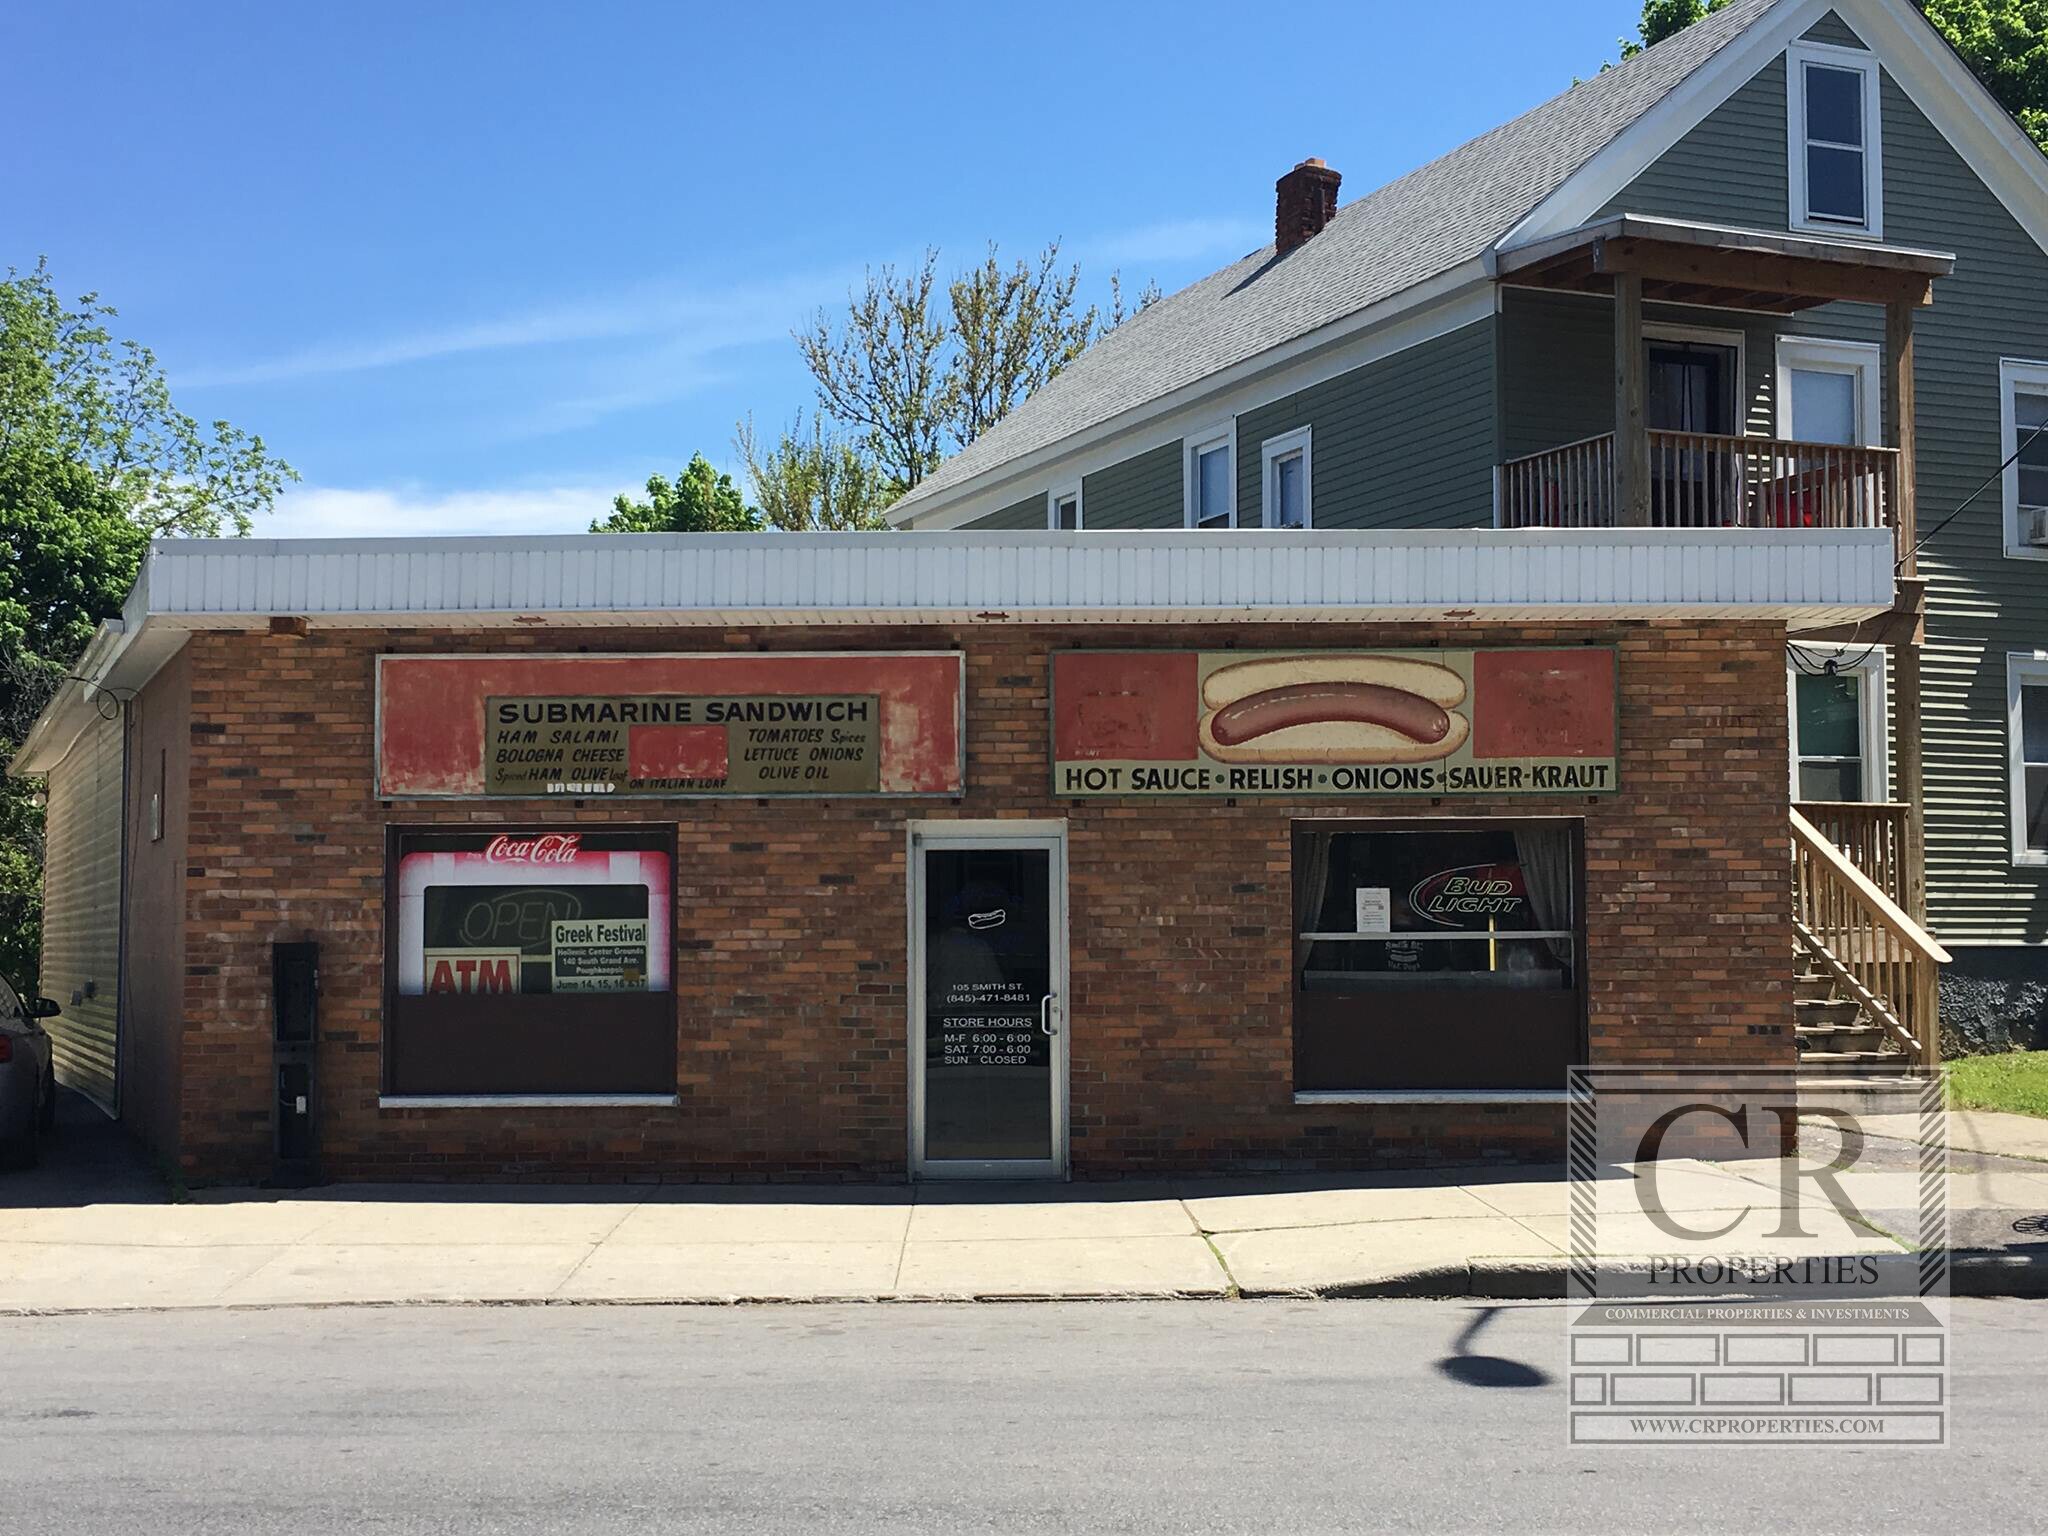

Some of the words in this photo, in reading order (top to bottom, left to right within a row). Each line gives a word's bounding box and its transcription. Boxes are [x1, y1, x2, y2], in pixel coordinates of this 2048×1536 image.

[499, 702, 692, 724] SUBMARINE
[705, 701, 868, 723] SANDWICH
[497, 730, 538, 744] HAM
[549, 729, 619, 744] SALAMI
[748, 728, 824, 743] TOMATOES
[830, 728, 866, 744] Spices
[495, 748, 564, 763] BOLOGNA
[572, 748, 625, 762] CHEESE
[743, 747, 799, 761] LETTUCE
[808, 747, 865, 761] ONIONS
[528, 767, 563, 781] HAM
[571, 767, 609, 781] OLIVE
[758, 766, 800, 780] OLIVE
[804, 765, 830, 779] OIL
[1065, 767, 1123, 791] HOT
[1131, 767, 1210, 791] SAUCE
[1228, 767, 1313, 791] RELISH
[1331, 766, 1435, 791] ONIONS
[1449, 764, 1609, 790] SAUER-KRAUT
[649, 779, 695, 789] ITALIAN
[486, 835, 580, 863] Coca-Cola
[1444, 877, 1512, 895] BUD
[1427, 896, 1522, 914] LIGHT
[463, 902, 572, 941] OPEN
[555, 924, 594, 943] Greek
[596, 922, 646, 942] Festival
[429, 959, 514, 994] ATM
[556, 980, 579, 990] June
[952, 983, 970, 991] 105
[972, 983, 1006, 991] SMITH
[946, 993, 1031, 1003] (845)-471-8481
[943, 1017, 985, 1028] STORE
[987, 1017, 1033, 1028] HOURS
[944, 1034, 966, 1043] M-F
[972, 1034, 997, 1043] 6:00
[1006, 1034, 1031, 1043] 6:00
[944, 1045, 969, 1054] SAT.
[973, 1045, 997, 1054] 7:00
[1006, 1045, 1031, 1054] 6:00
[980, 1055, 1027, 1065] CLOSED
